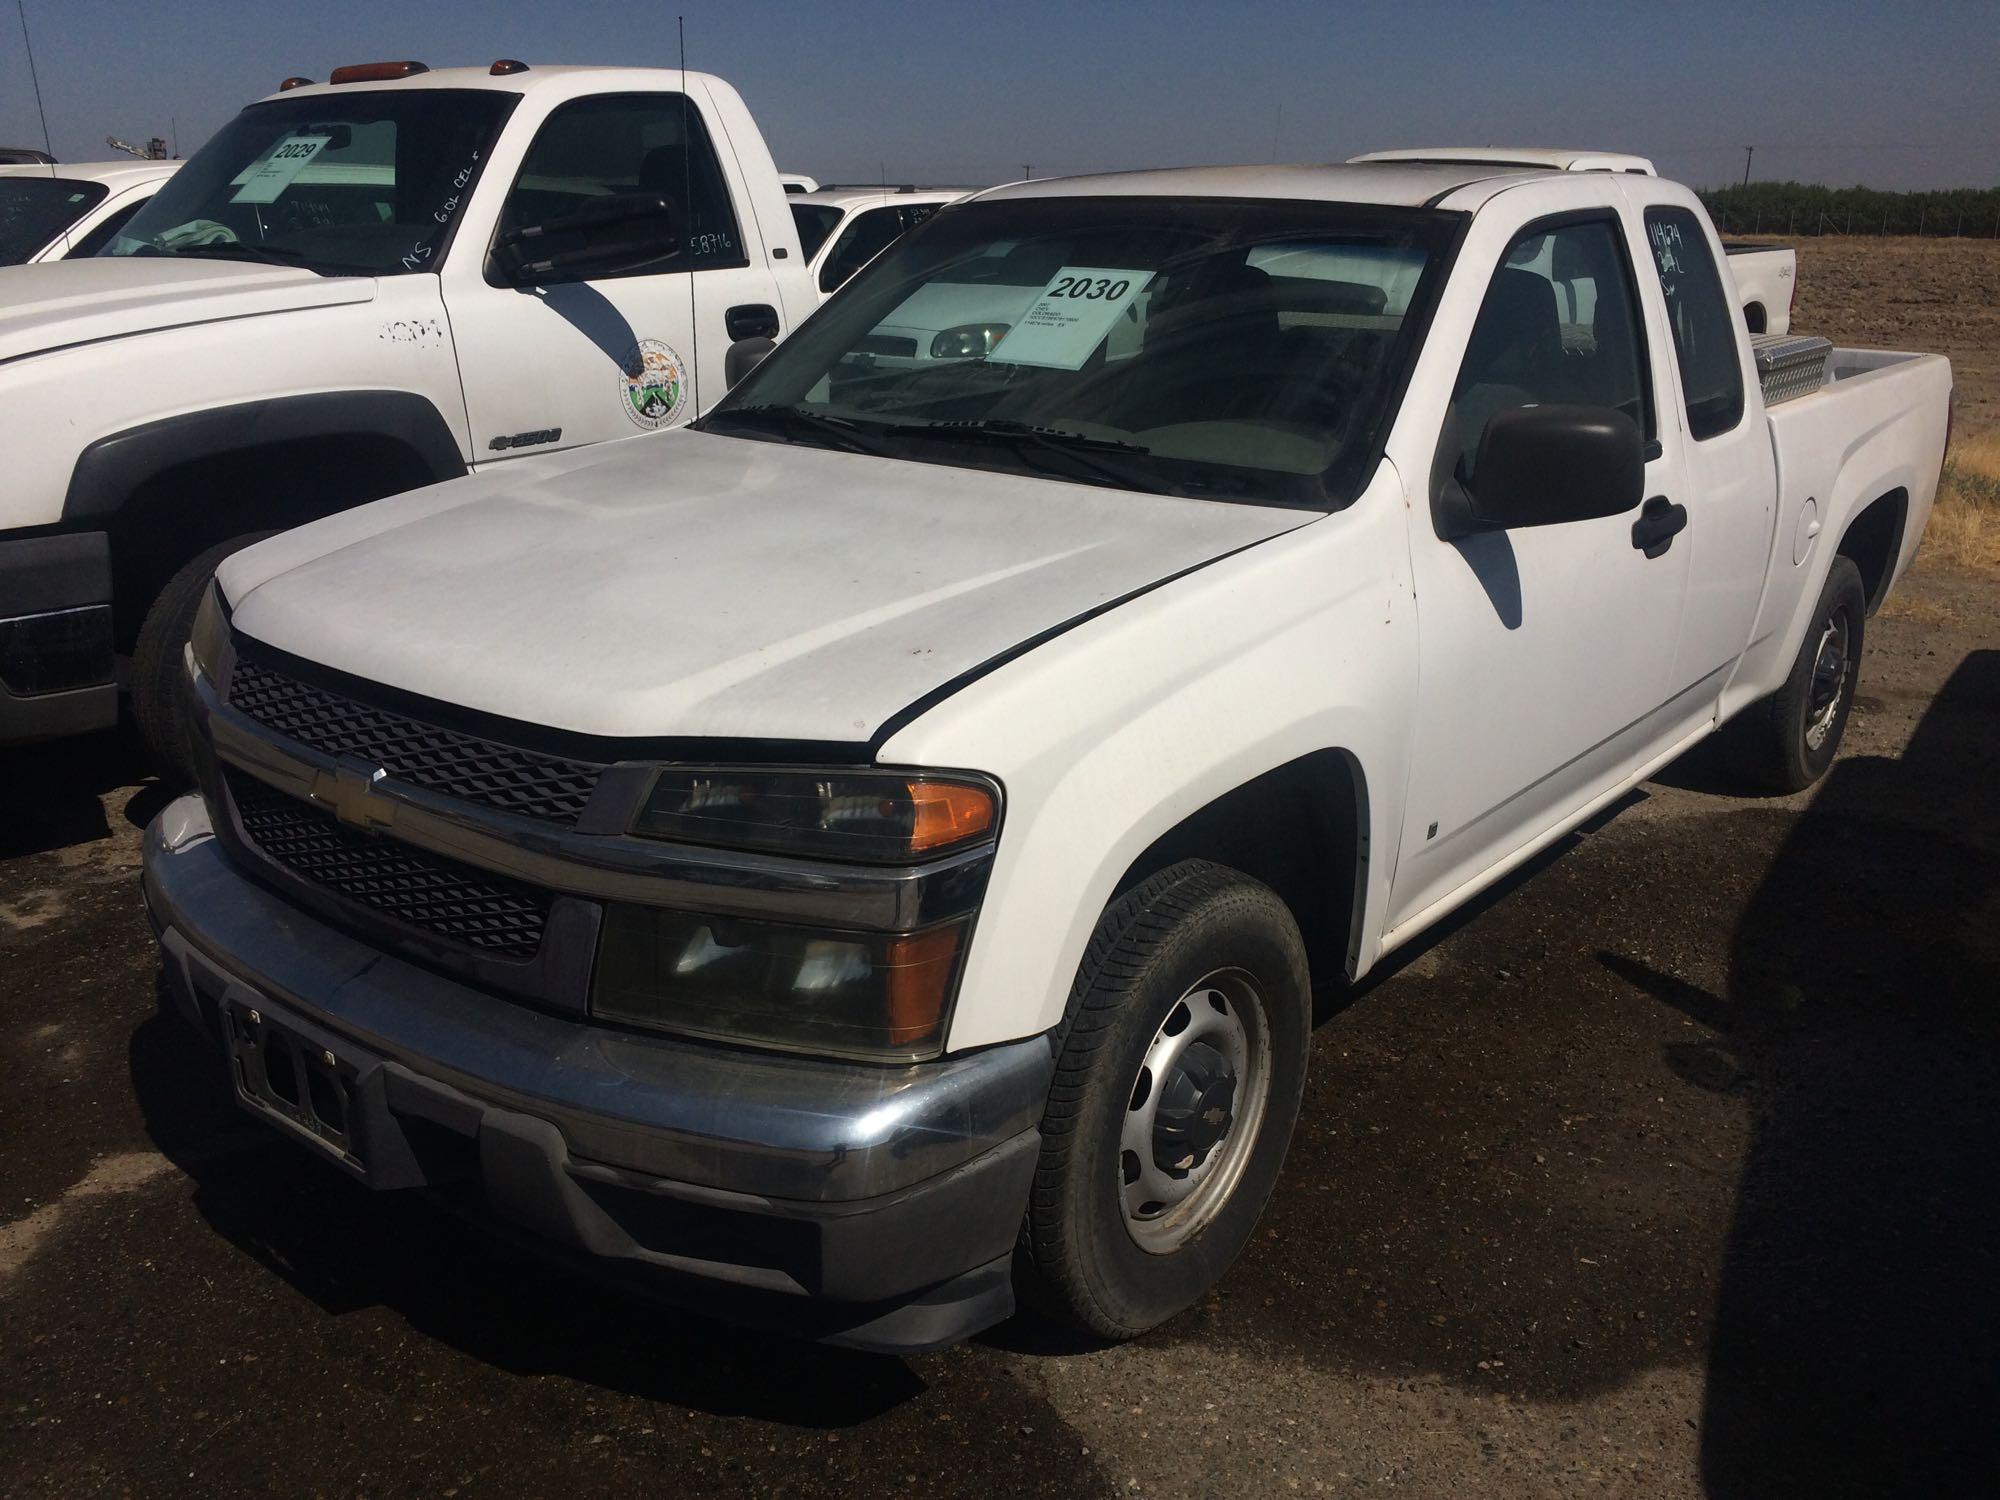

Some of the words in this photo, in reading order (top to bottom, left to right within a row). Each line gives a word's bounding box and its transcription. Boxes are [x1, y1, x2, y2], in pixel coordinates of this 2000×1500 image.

[274, 143, 317, 158] 2029
[690, 233, 731, 255] 58716
[1047, 277, 1130, 301] 2030
